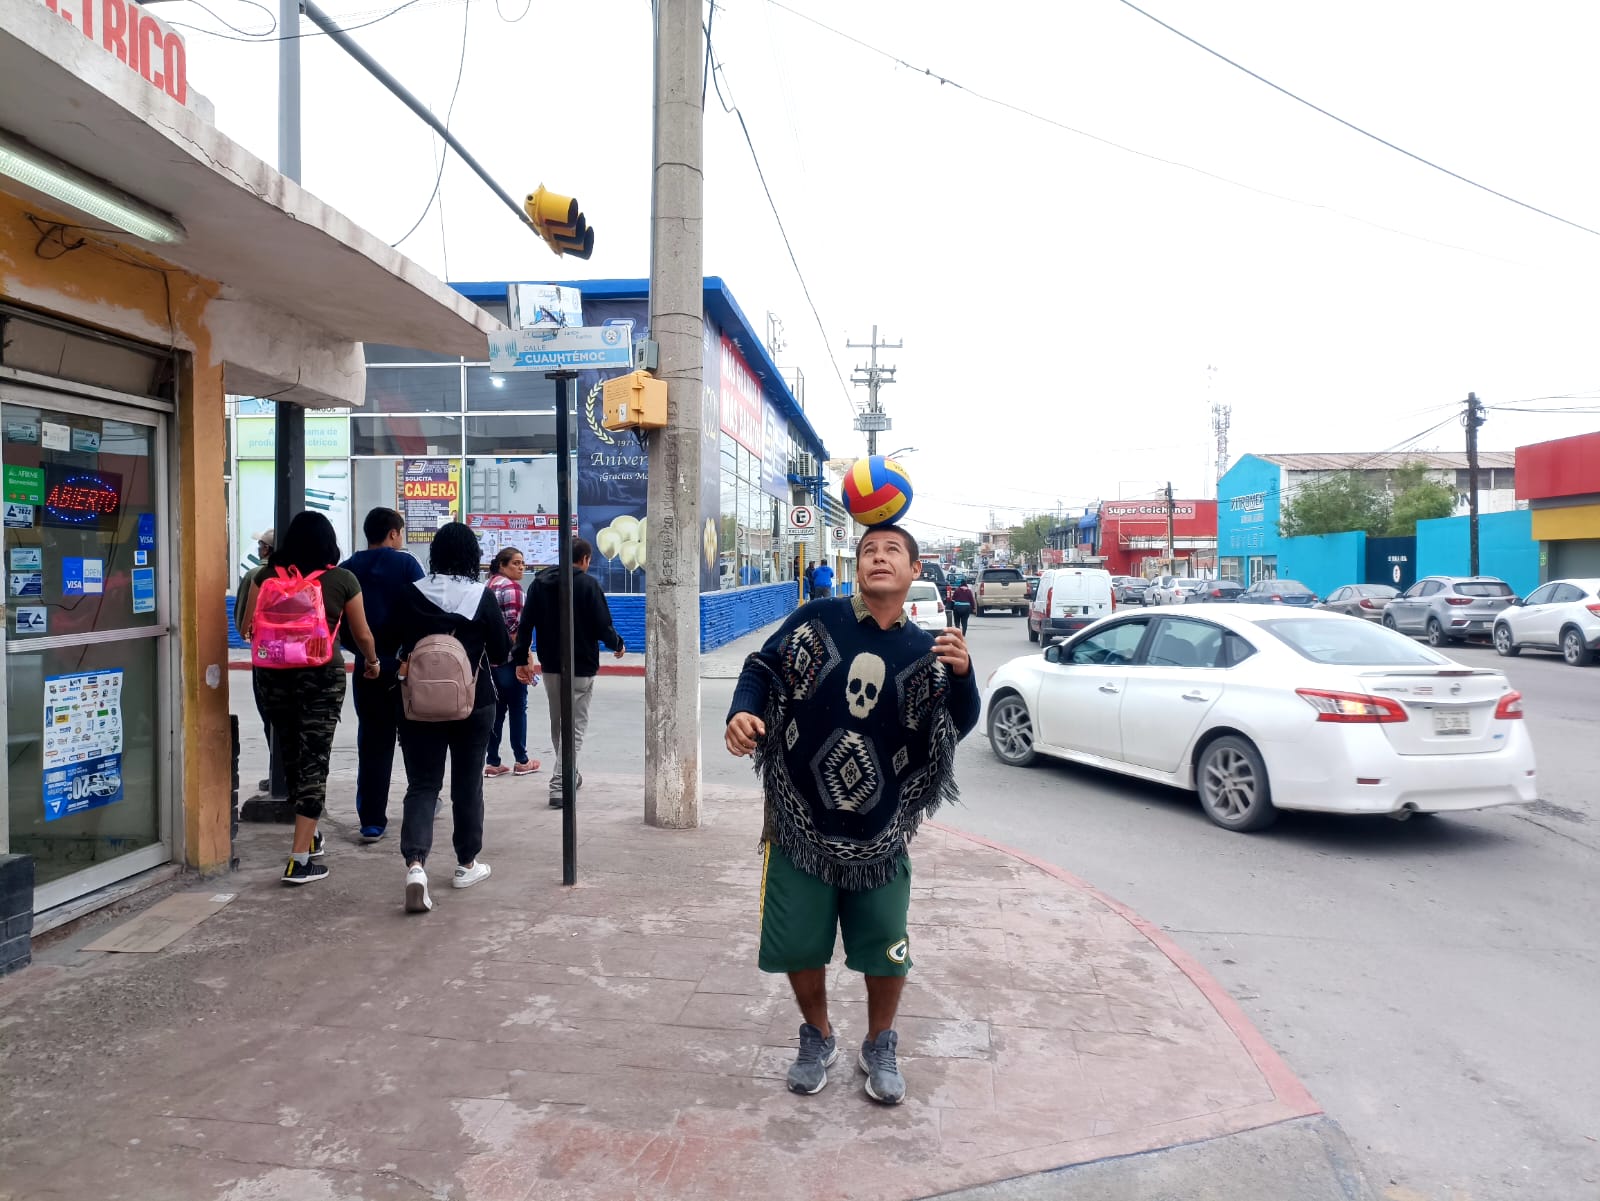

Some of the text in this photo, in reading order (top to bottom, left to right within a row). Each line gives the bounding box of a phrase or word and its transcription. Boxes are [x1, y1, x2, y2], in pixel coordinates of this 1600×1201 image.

[45, 0, 187, 106] TRICO
[525, 350, 606, 364] CUAUHTÉMOC
[591, 452, 648, 467] Aniver
[405, 482, 457, 497] CAJERA
[45, 484, 118, 513] ABIERTO
[1107, 505, 1193, 516] Super Colchnes
[139, 535, 154, 544] VISA
[66, 580, 82, 589] VISA
